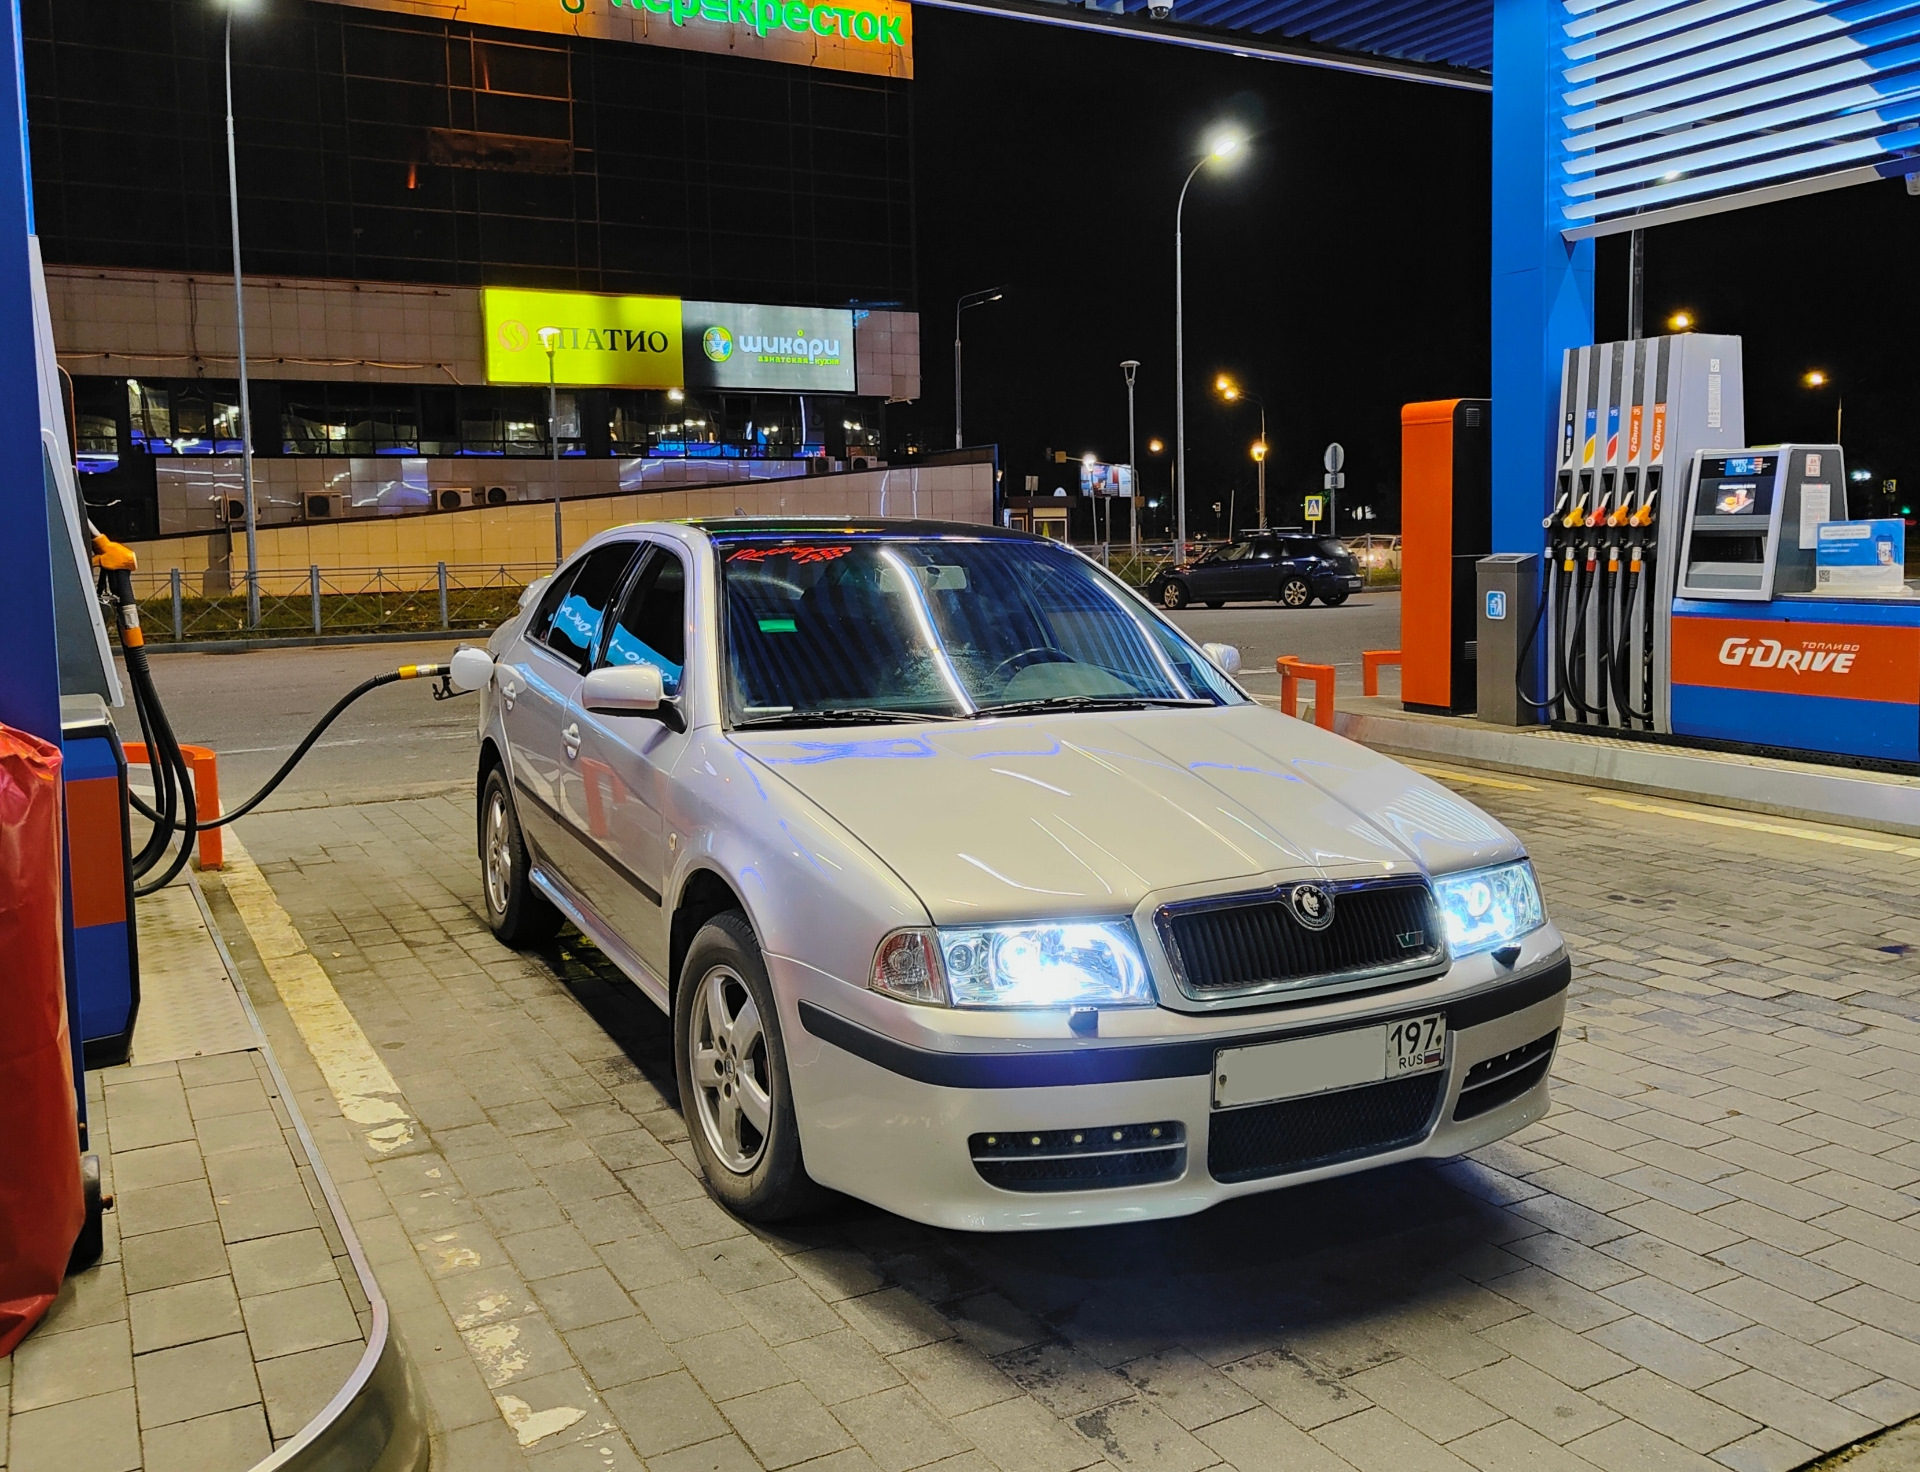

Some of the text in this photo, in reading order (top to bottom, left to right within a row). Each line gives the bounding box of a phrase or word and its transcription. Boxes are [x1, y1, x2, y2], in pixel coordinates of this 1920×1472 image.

[611, 0, 905, 46] рекресток
[557, 326, 669, 353] ПАТИО
[1587, 411, 1596, 419] 92
[1609, 409, 1618, 417] 95
[1802, 641, 1860, 652] ТОПЛИВО
[1390, 1017, 1438, 1057] 197
[1399, 1053, 1423, 1070] RUS
